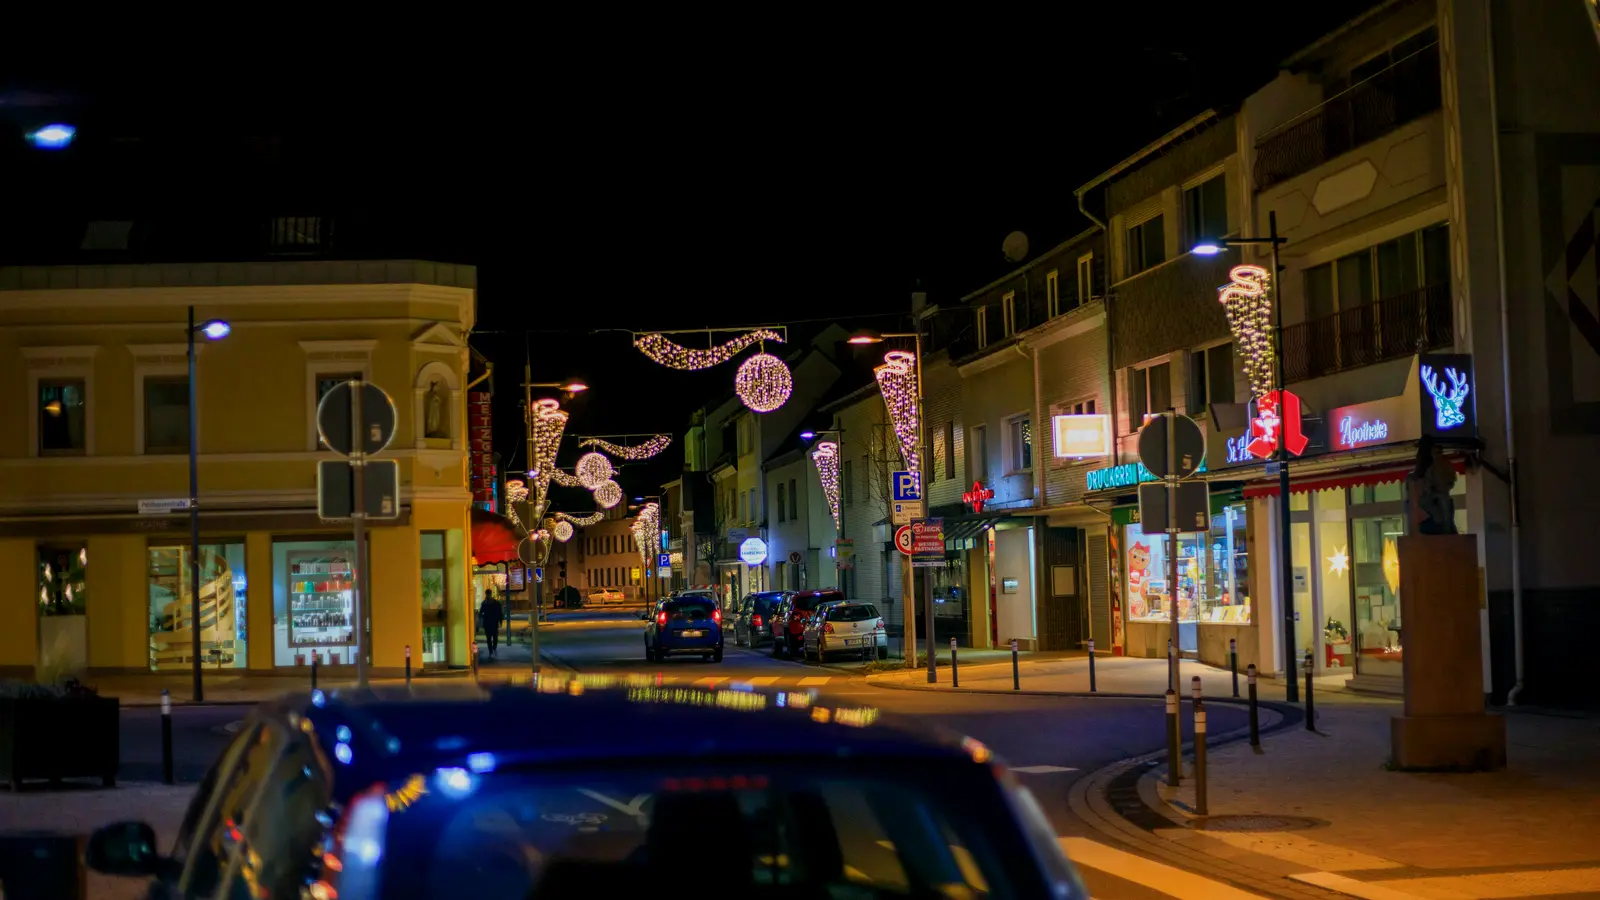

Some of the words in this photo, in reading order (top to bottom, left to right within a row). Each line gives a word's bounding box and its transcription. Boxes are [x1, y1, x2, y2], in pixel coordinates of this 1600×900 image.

[1339, 415, 1388, 448] Apotheke
[900, 475, 914, 497] P
[1086, 463, 1133, 490] DRUCKEREI
[660, 555, 668, 566] P
